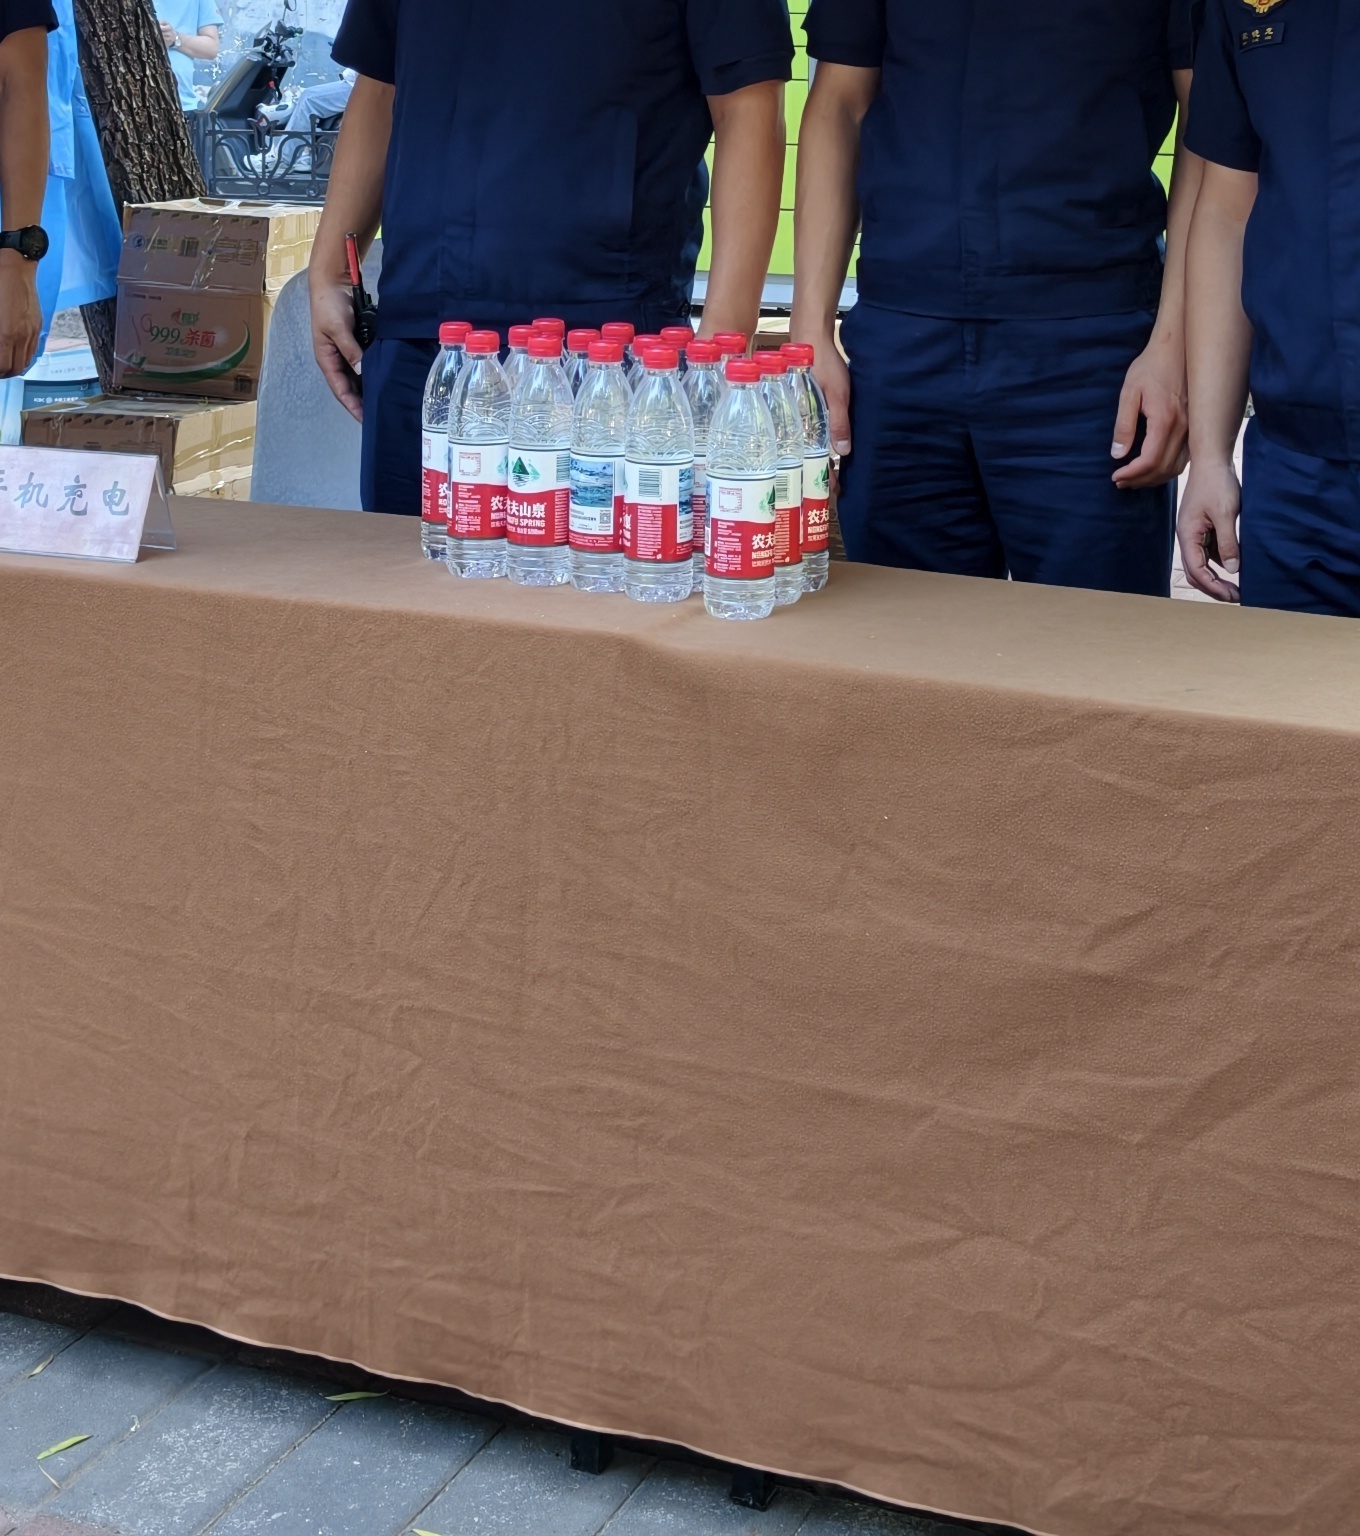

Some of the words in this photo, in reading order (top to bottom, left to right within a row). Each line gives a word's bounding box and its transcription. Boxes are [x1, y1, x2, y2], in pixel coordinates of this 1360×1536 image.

[150, 325, 181, 346] 999
[185, 328, 218, 350] 杀菌
[507, 499, 546, 518] 夫山泉
[520, 518, 546, 528] SPRING
